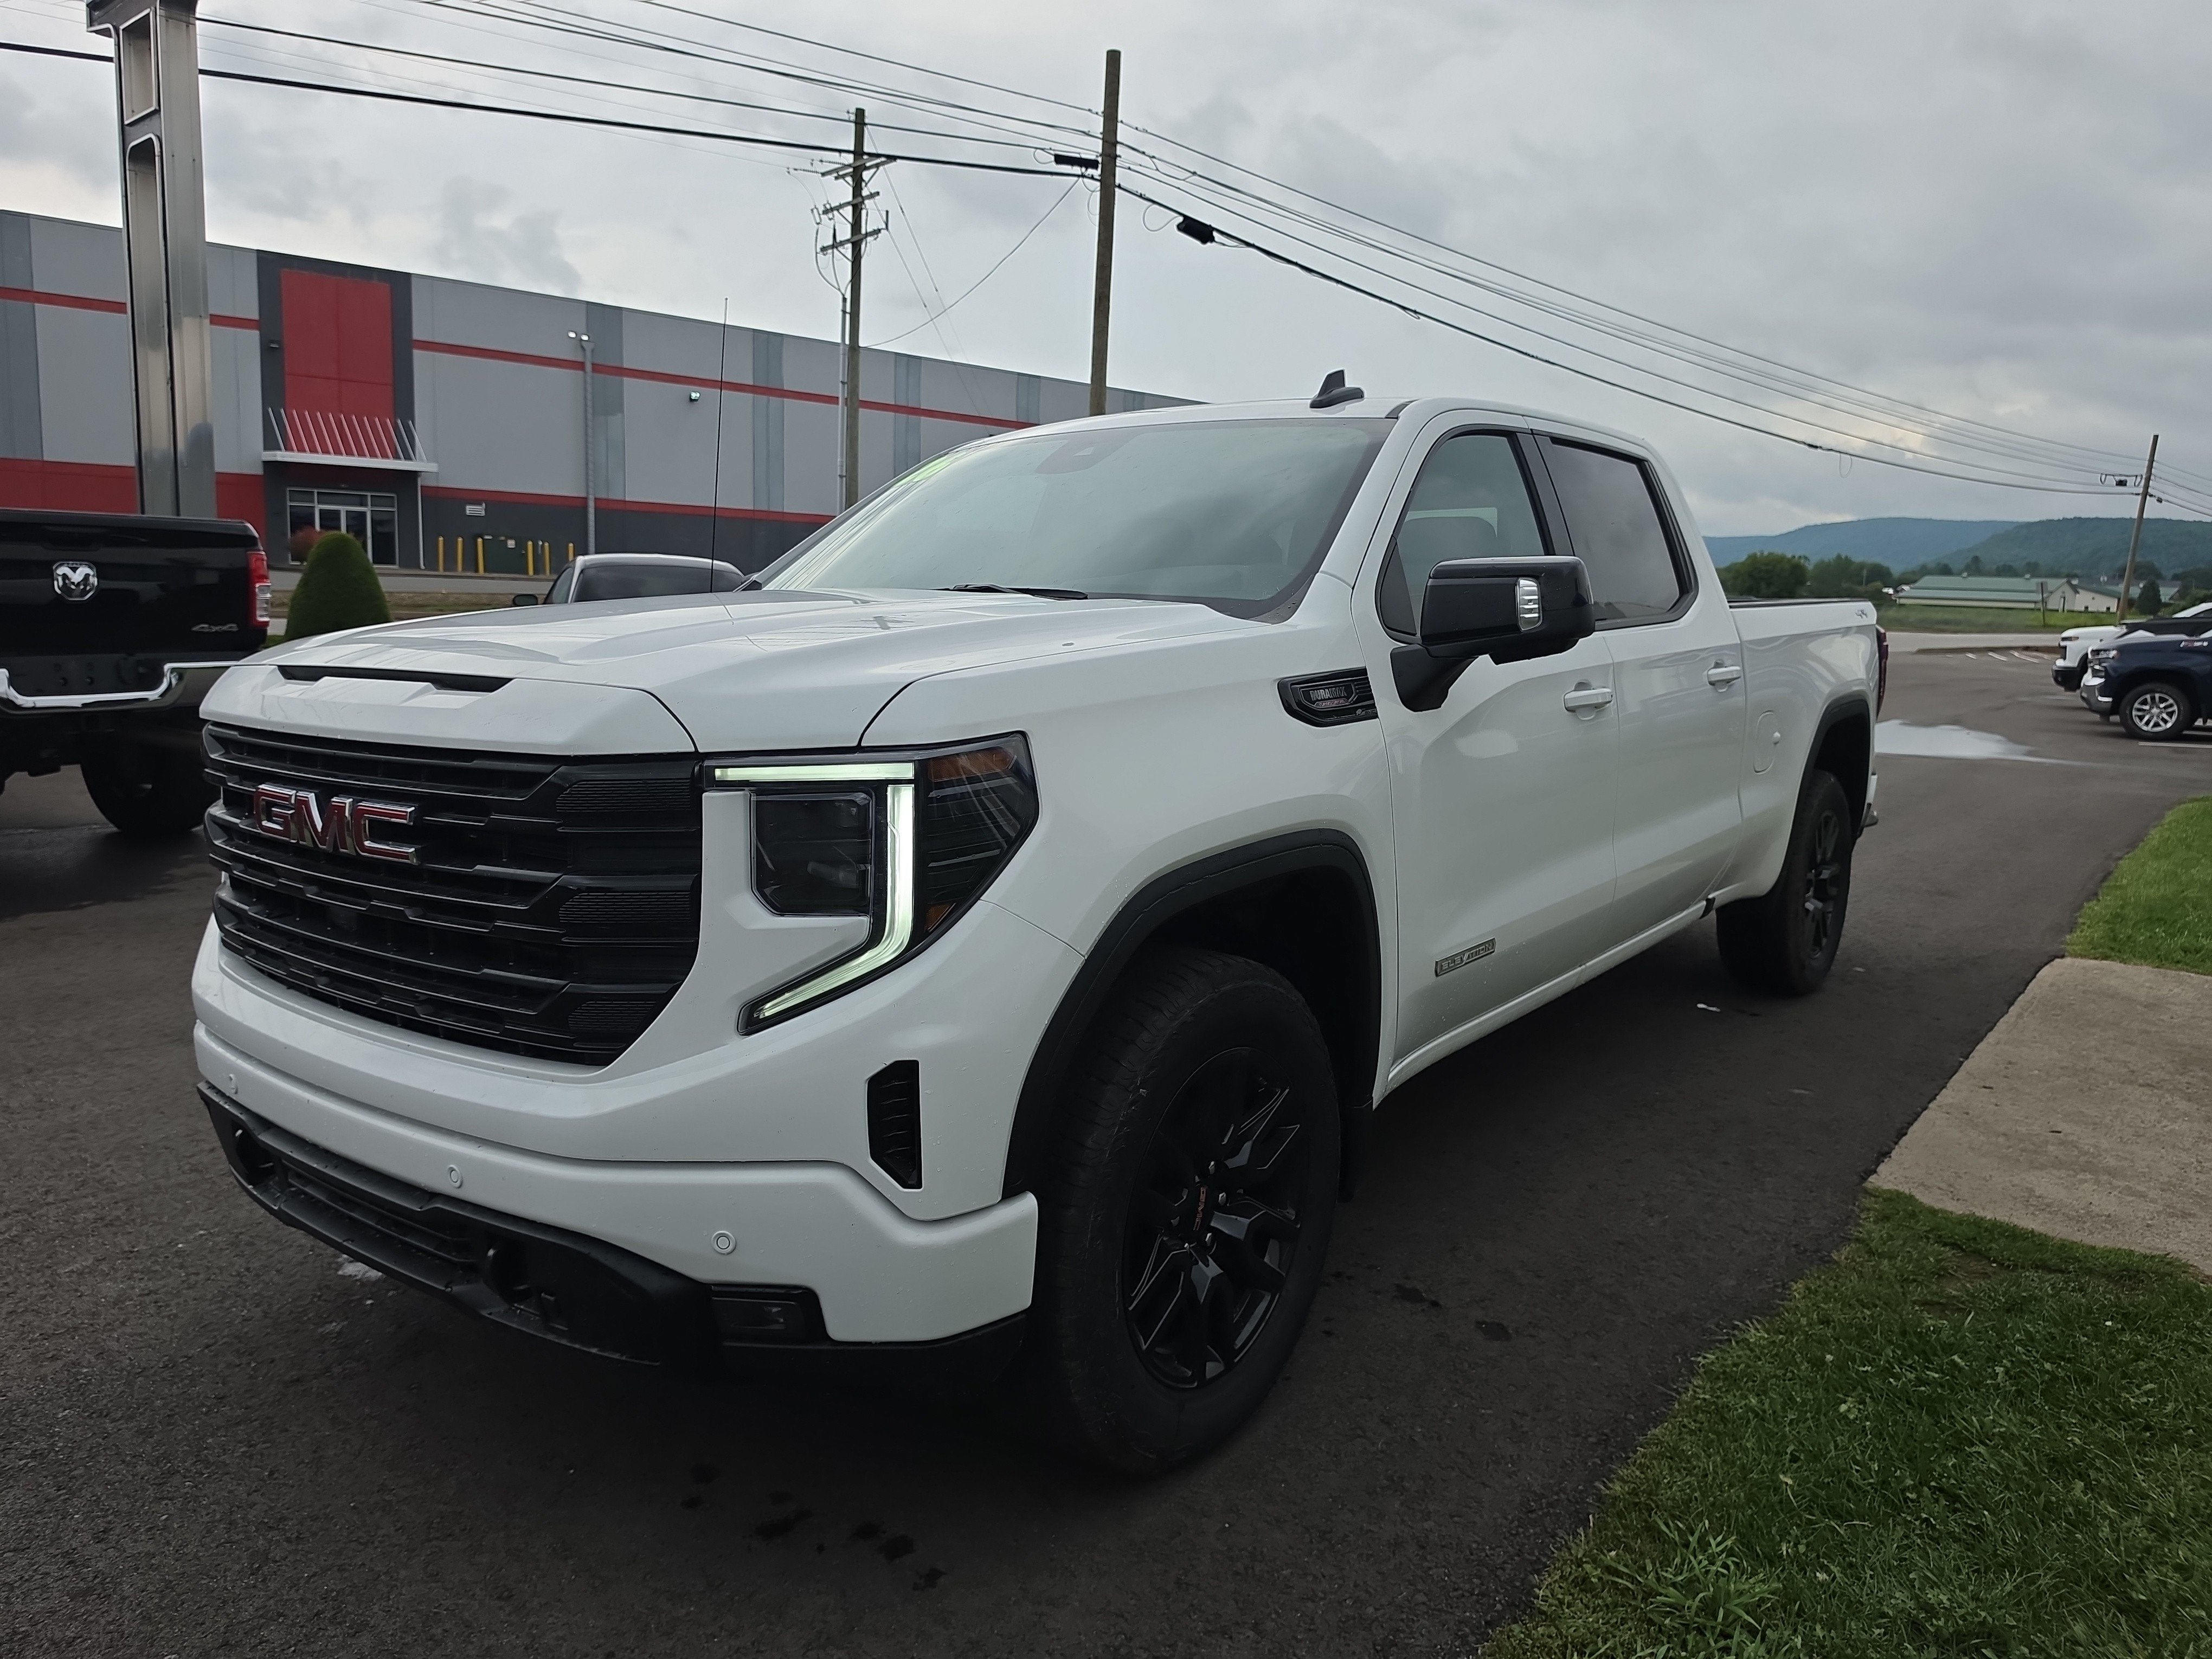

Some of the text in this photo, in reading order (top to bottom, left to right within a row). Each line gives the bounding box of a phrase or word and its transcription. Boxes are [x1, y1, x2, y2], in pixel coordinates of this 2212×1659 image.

[1309, 686, 1347, 701] DURAMAX
[254, 784, 420, 865] GMC
[1441, 942, 1492, 970] ELEVATION
[1193, 1186, 1207, 1231] GMC
